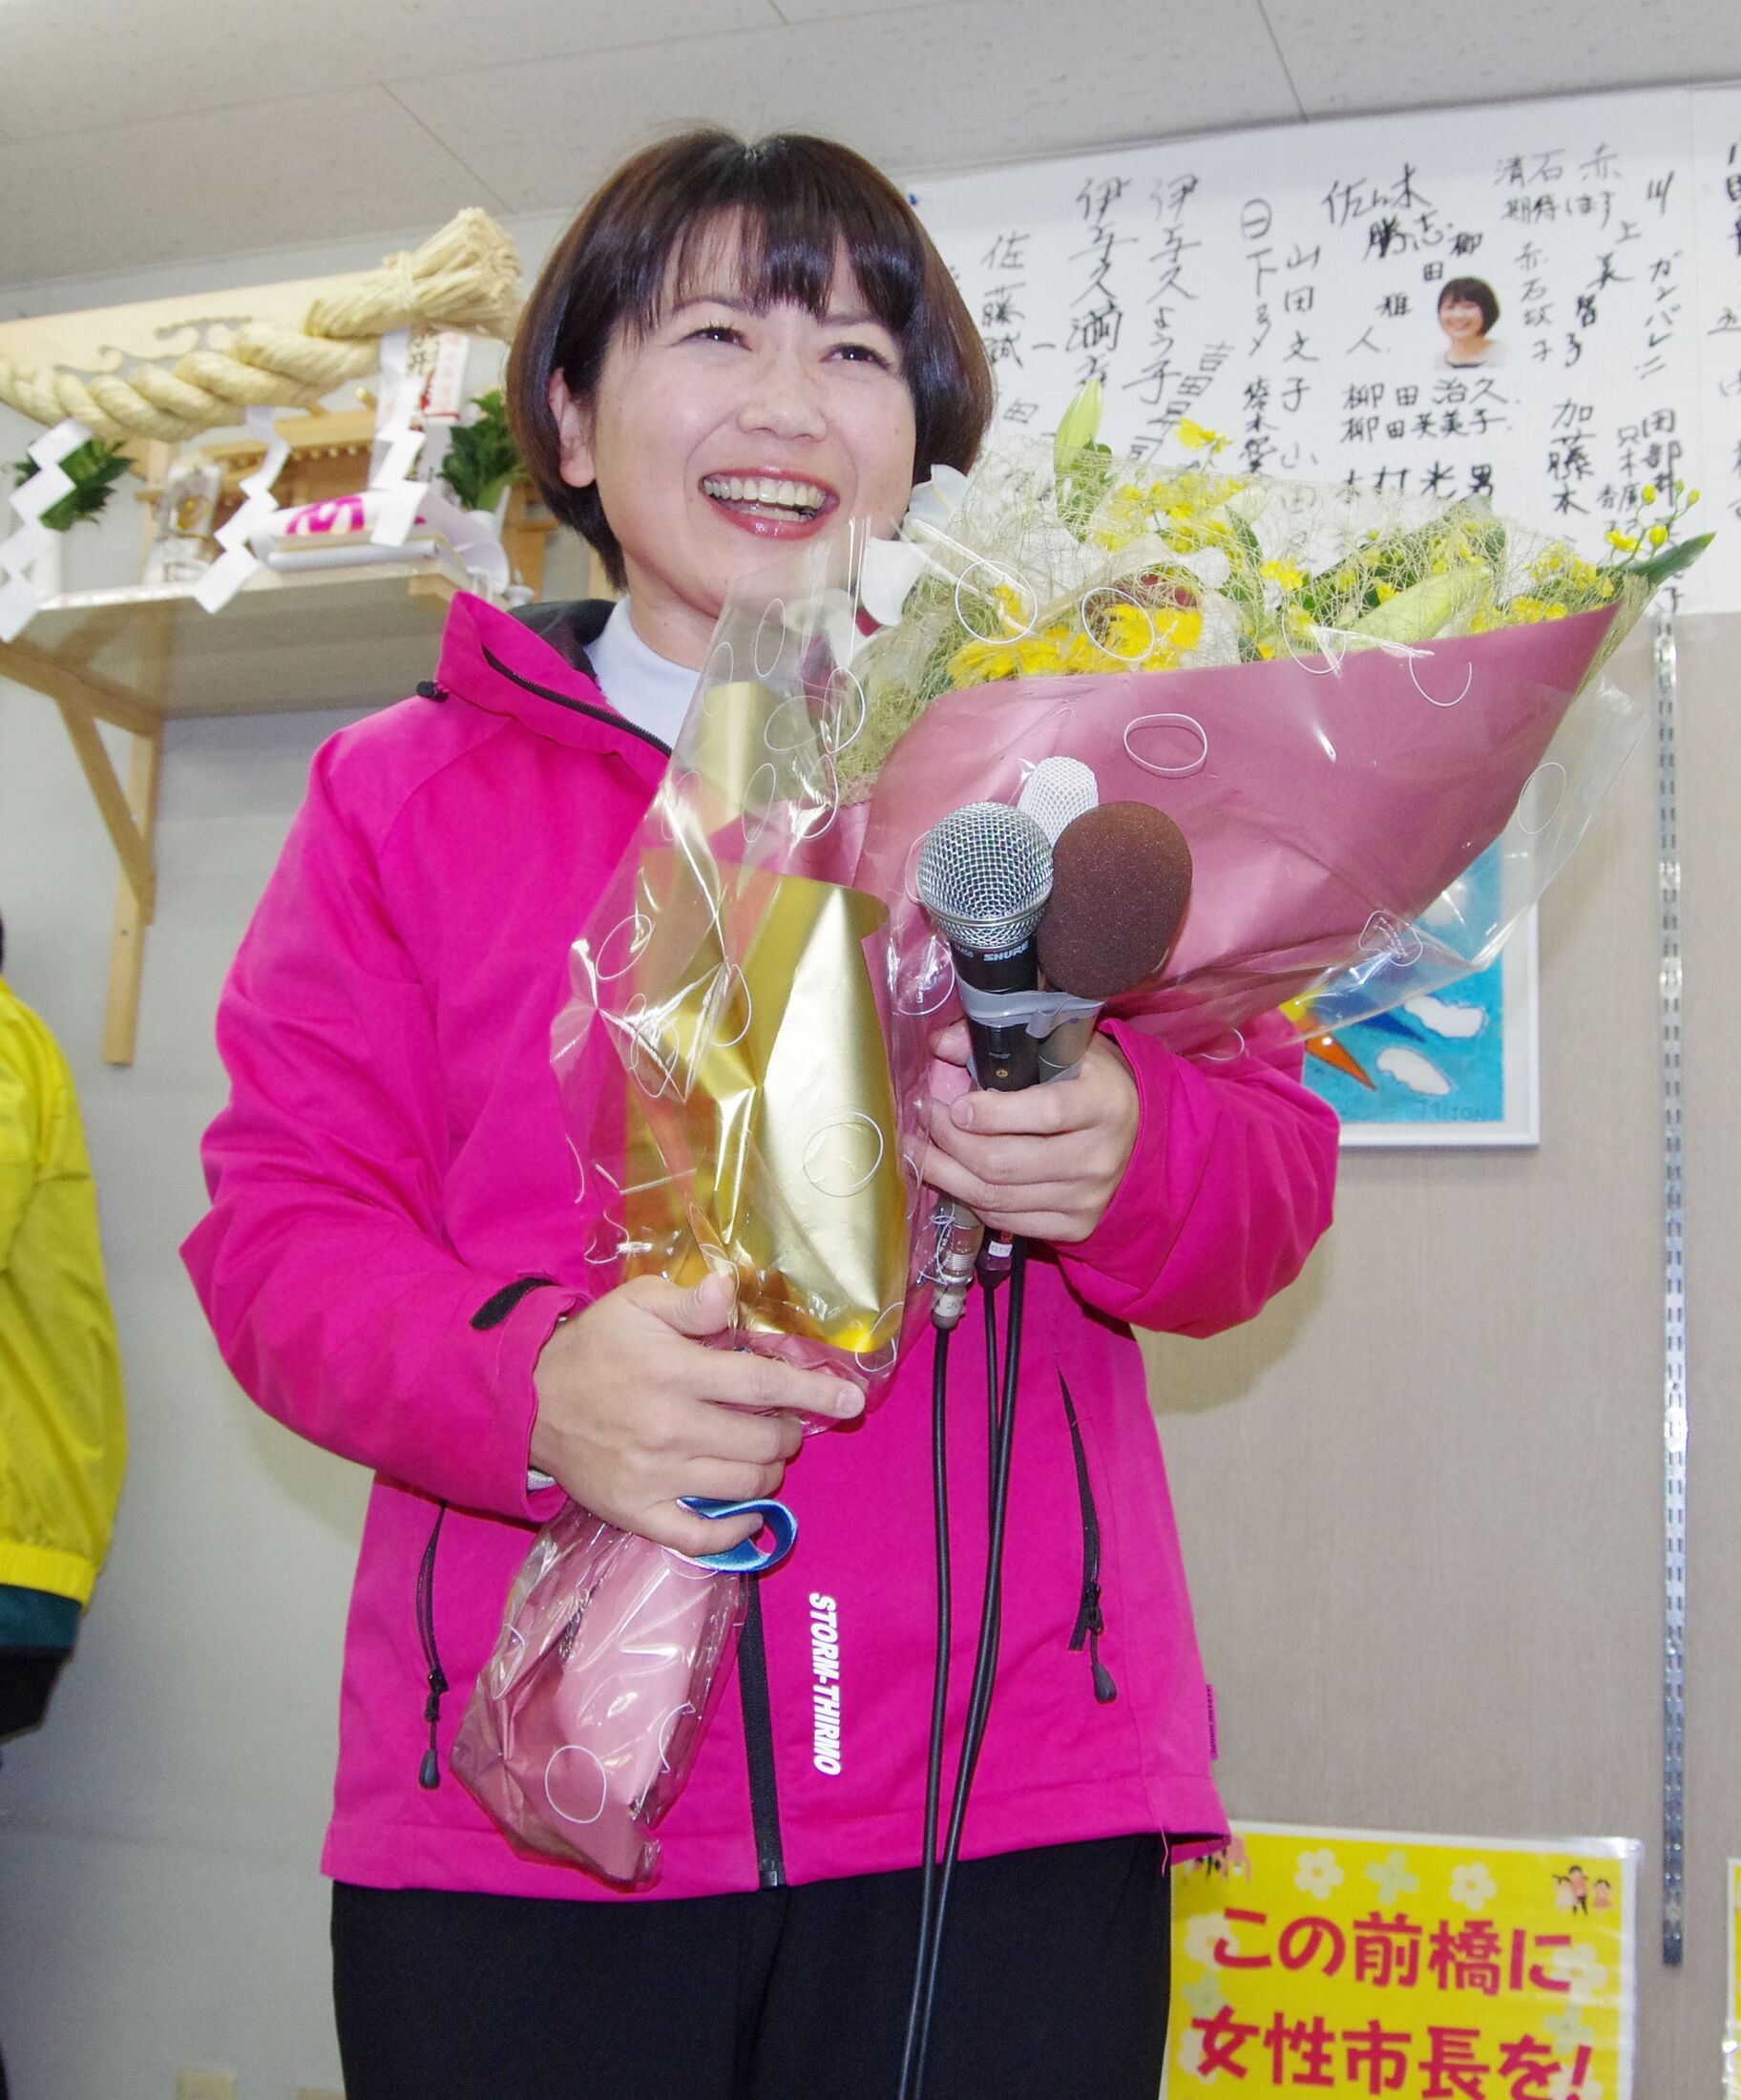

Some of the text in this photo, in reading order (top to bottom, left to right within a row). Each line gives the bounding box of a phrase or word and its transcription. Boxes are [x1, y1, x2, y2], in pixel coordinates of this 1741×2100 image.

[983, 939, 1029, 962] SHURE
[809, 1592, 842, 1776] STORM-THIRMO
[1213, 1907, 1572, 1997] この前橋に
[1191, 2006, 1593, 2100] 女性市長を!
